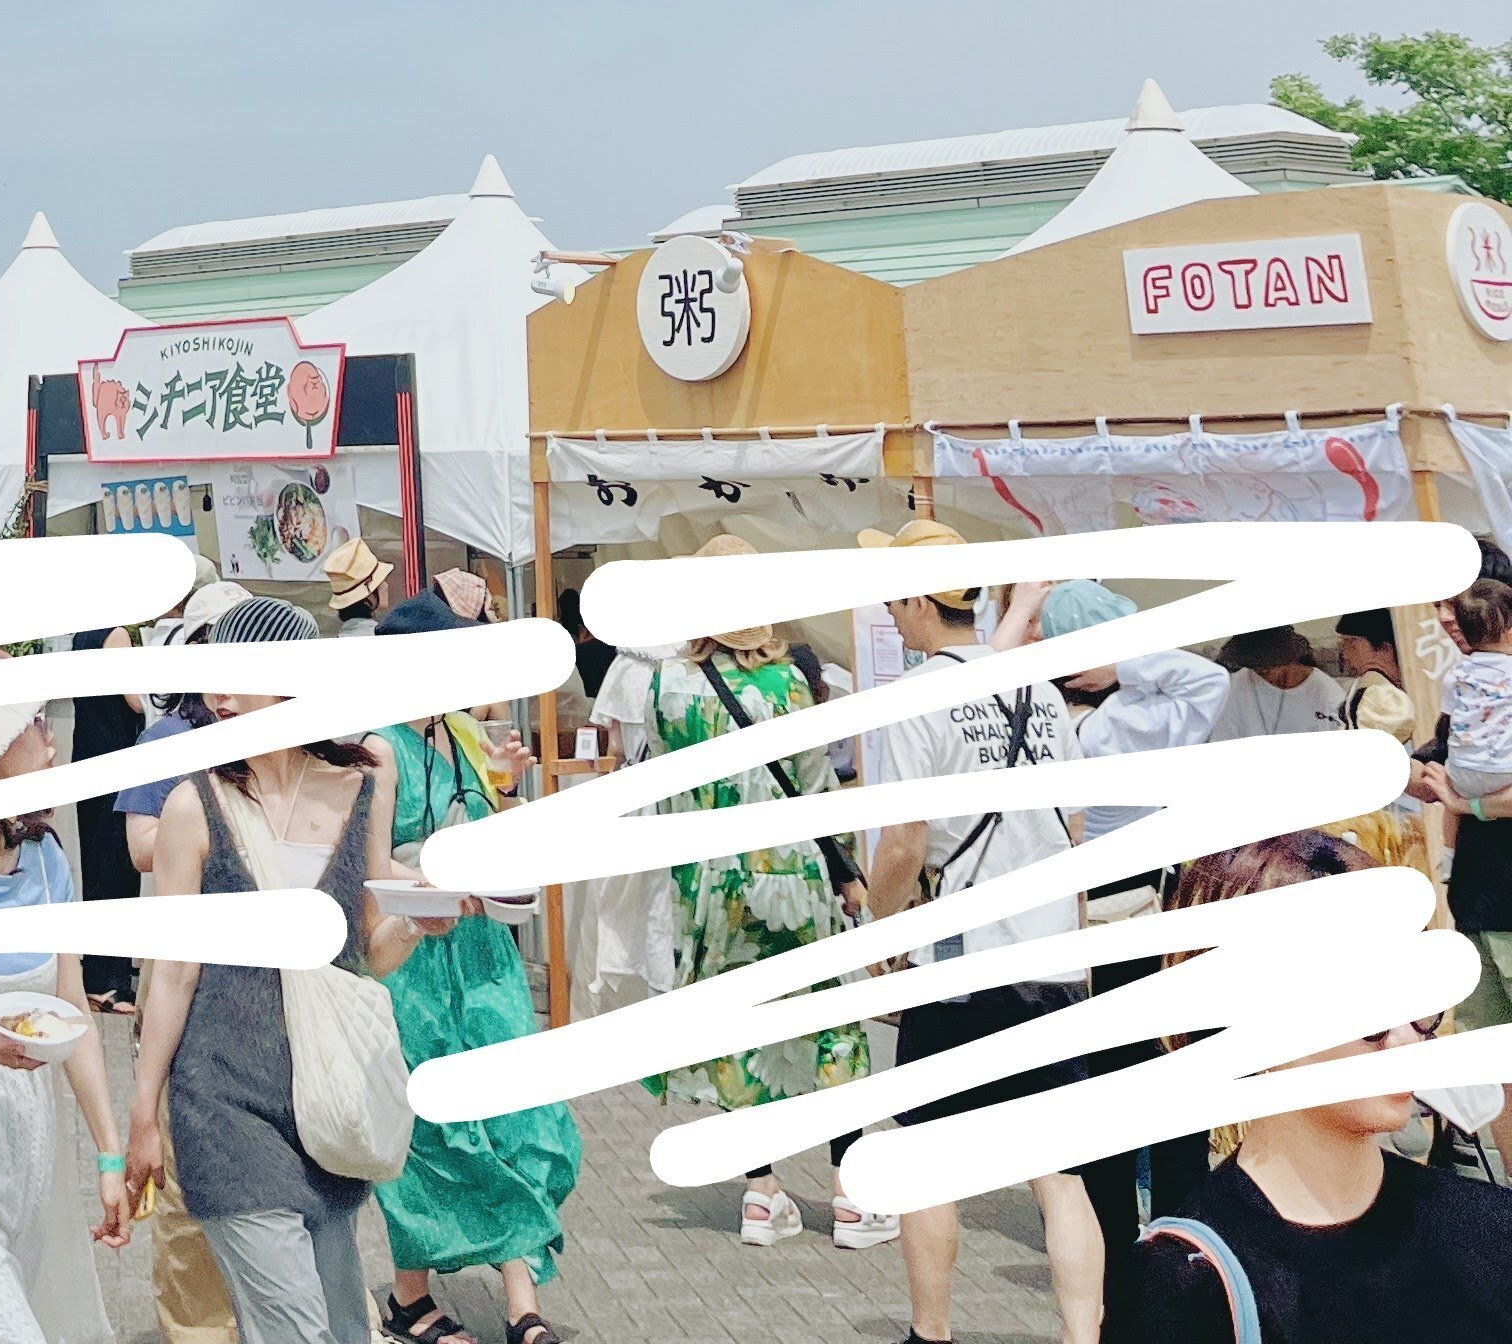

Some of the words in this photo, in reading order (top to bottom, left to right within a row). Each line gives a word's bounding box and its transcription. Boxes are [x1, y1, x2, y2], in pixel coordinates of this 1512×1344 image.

[658, 268, 716, 347] 粥
[1143, 254, 1349, 314] FOTAN
[160, 336, 254, 361] KIYOSHIKOJIN
[132, 360, 287, 441] シチニア食堂
